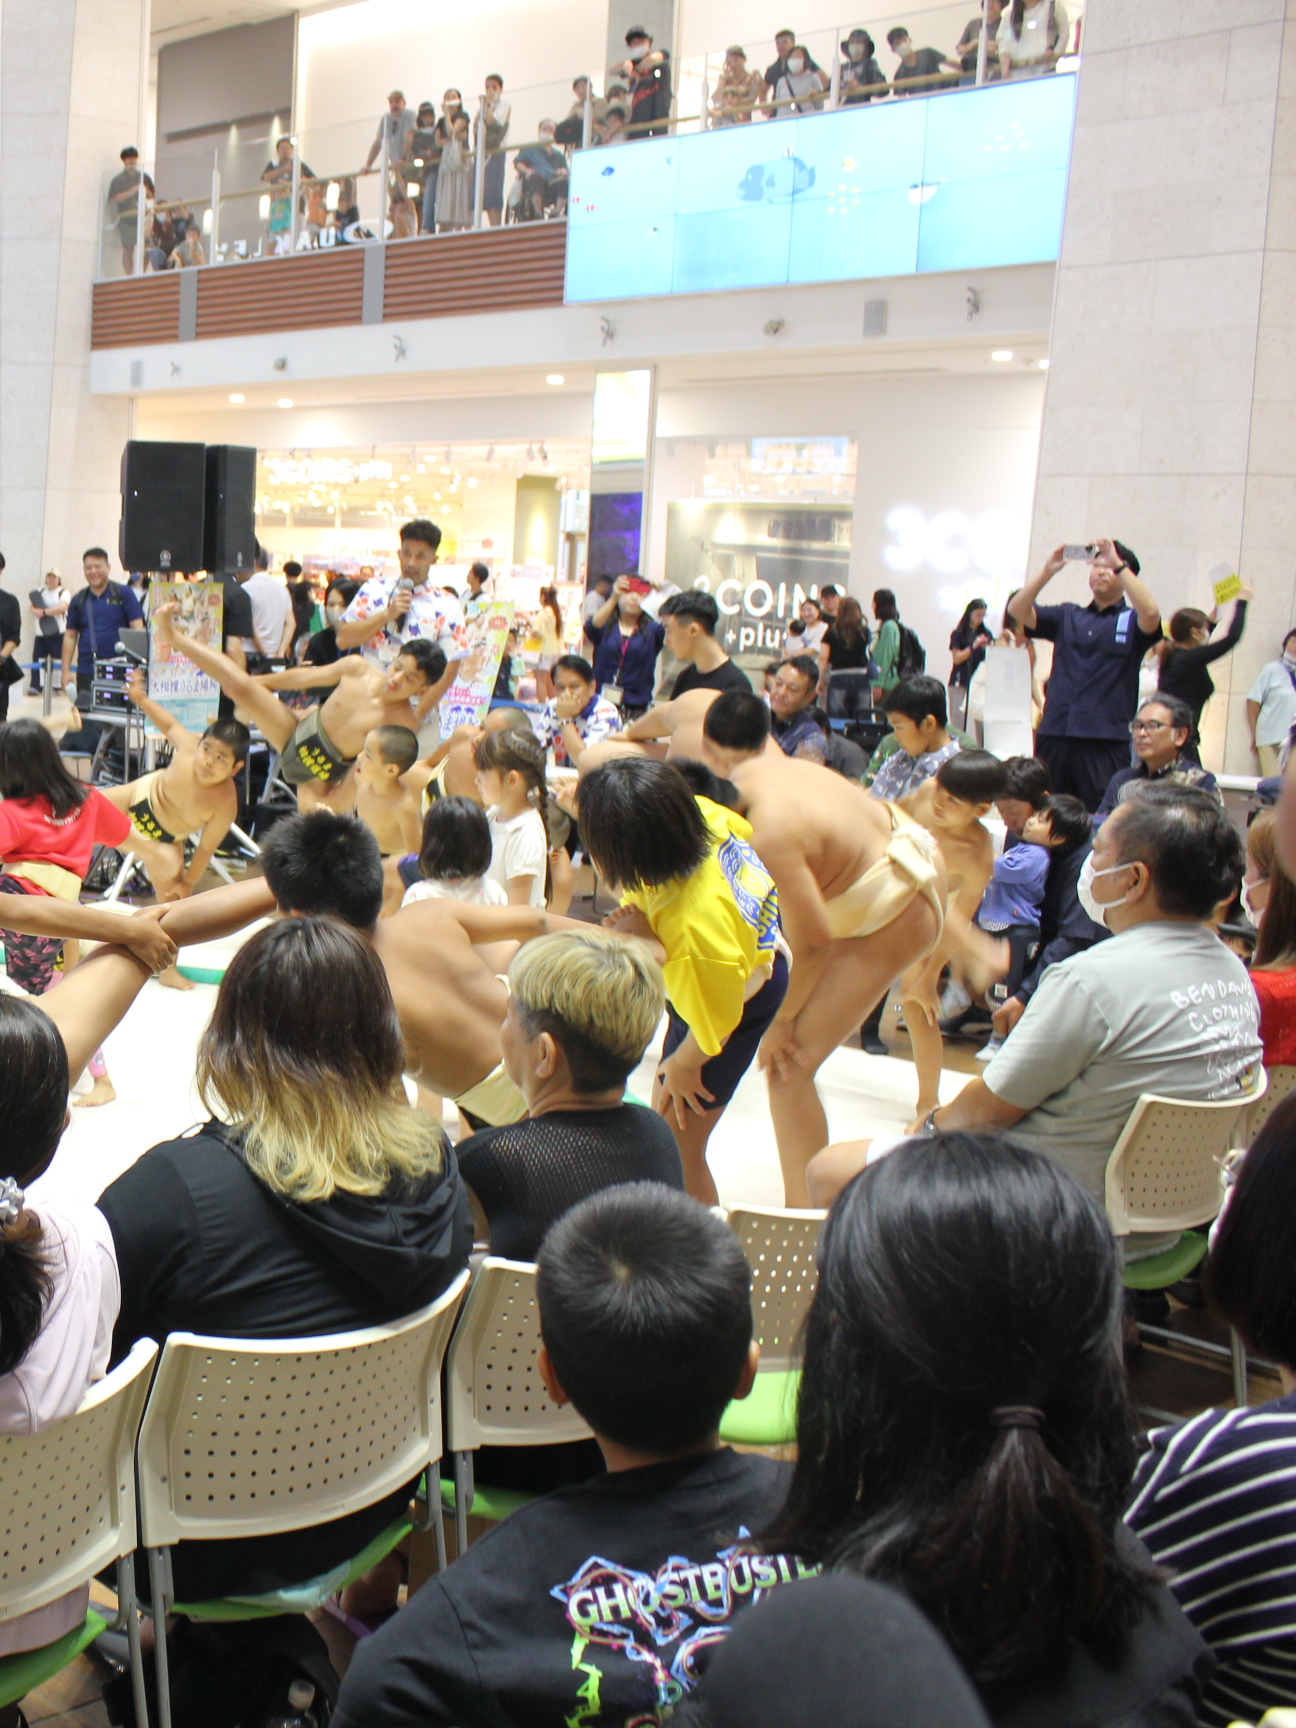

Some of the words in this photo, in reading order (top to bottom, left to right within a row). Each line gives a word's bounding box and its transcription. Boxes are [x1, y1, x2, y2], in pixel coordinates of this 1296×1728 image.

[693, 575, 846, 619] COIN
[725, 622, 787, 652] +plu
[1170, 982, 1215, 1009] BEN
[1188, 1001, 1256, 1033] CLOTHIN
